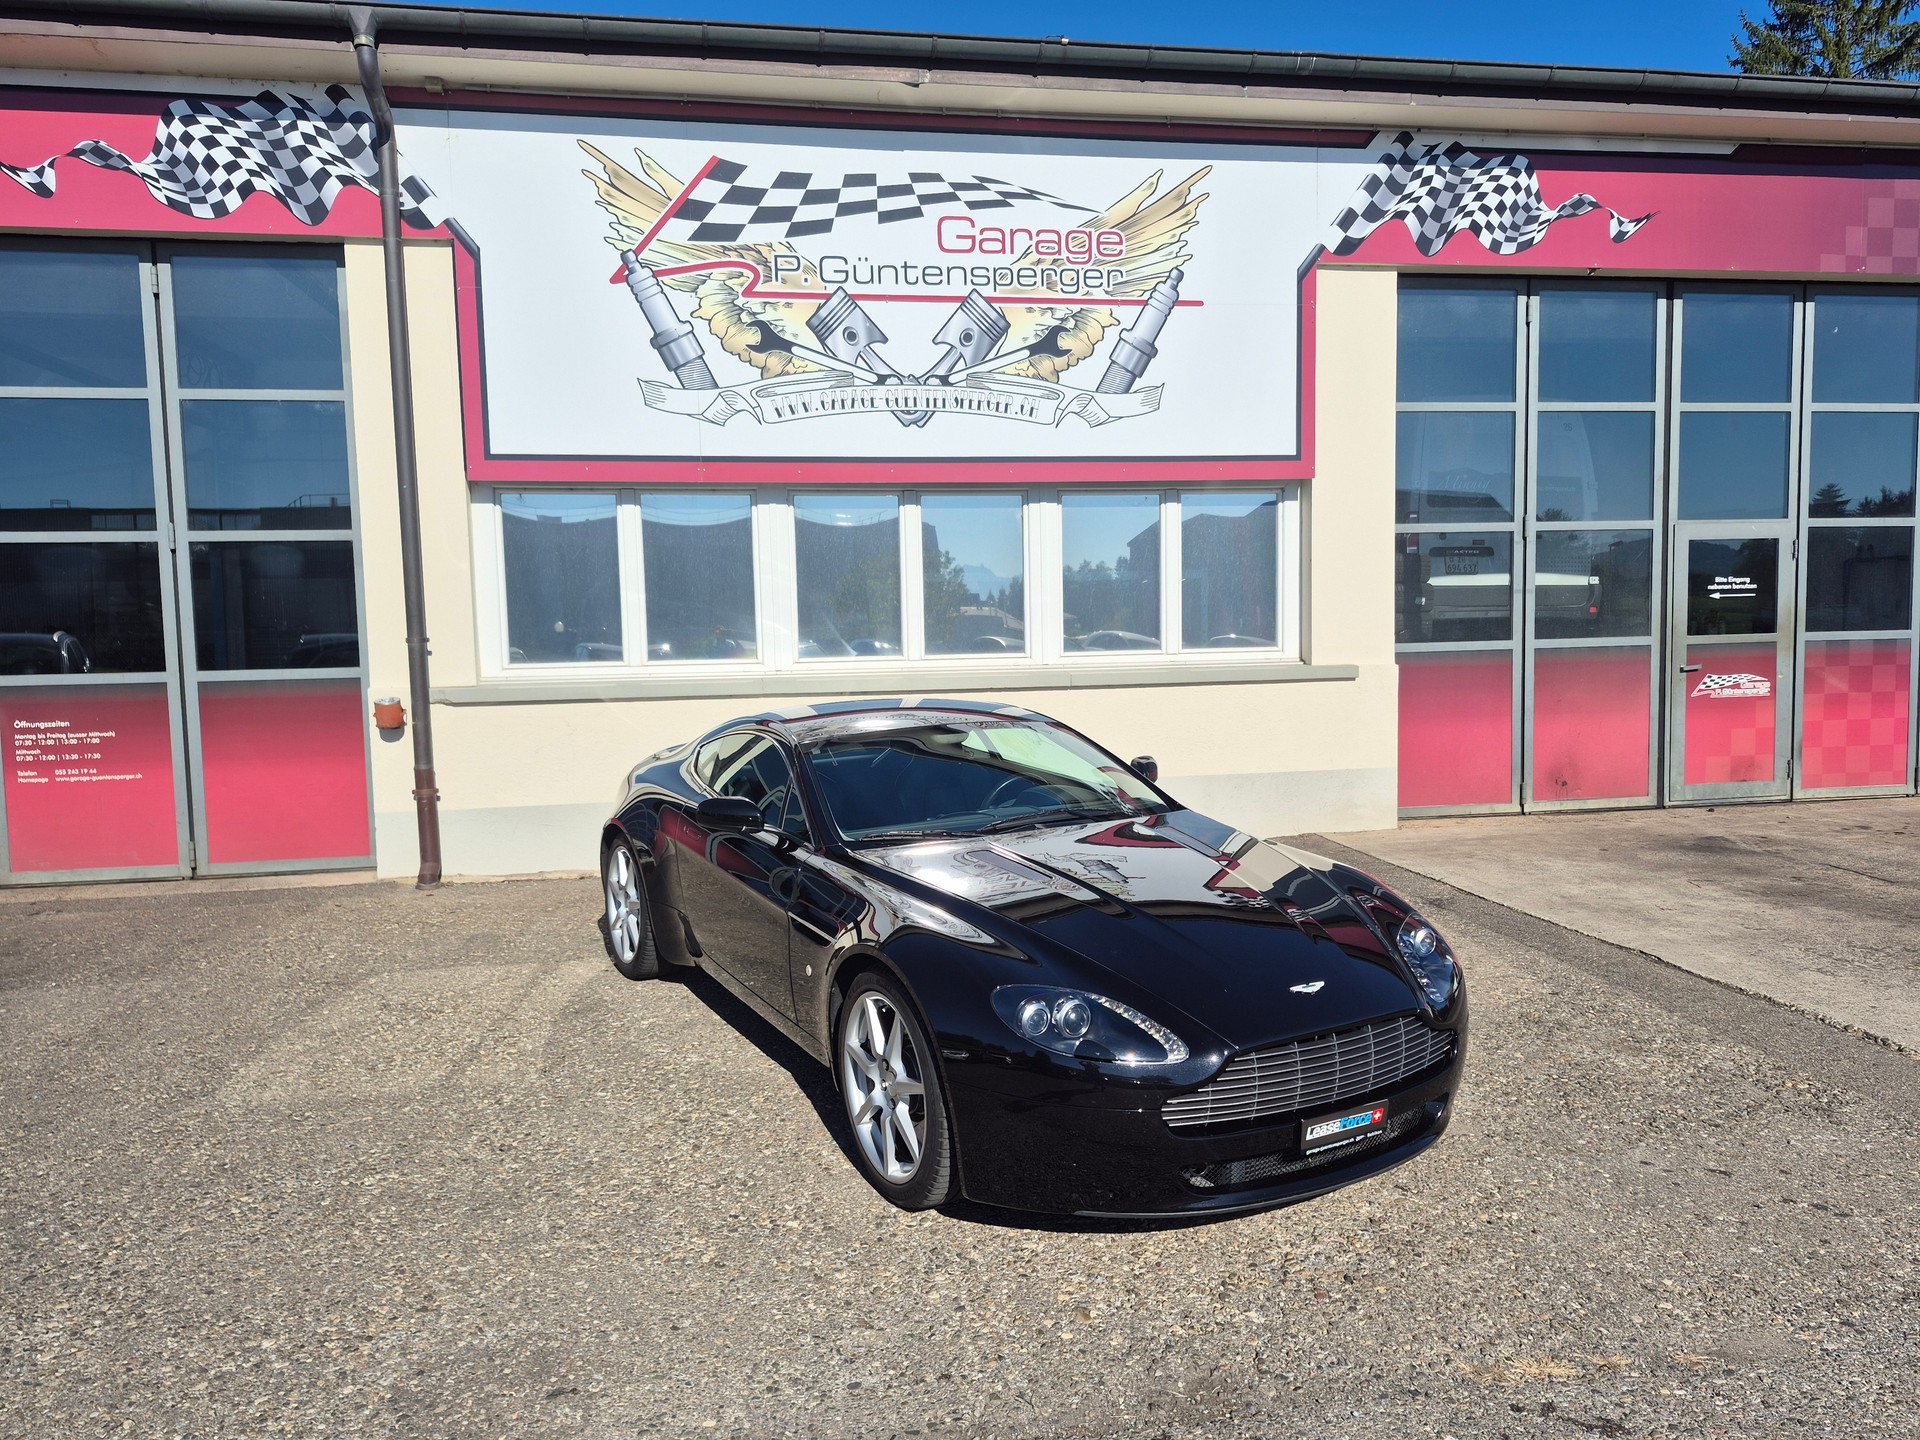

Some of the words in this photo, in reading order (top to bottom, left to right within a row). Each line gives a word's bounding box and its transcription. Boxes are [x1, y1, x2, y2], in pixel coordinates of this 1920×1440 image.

[936, 215, 1125, 266] Garage
[772, 254, 809, 284] P.
[818, 255, 1124, 295] Güntensperger
[771, 387, 1041, 419] WWW.GARAGE-GUENTENSPERGER.CH
[1728, 576, 1751, 584] Eingang
[13, 720, 71, 730] Öffnungszeiten
[14, 733, 37, 741] Montag
[46, 731, 67, 739] Freitag
[67, 731, 88, 739] (ausser
[88, 730, 116, 738] Mittwoch)
[84, 752, 101, 760] 17:30
[1306, 1113, 1373, 1141] LeaseForce
